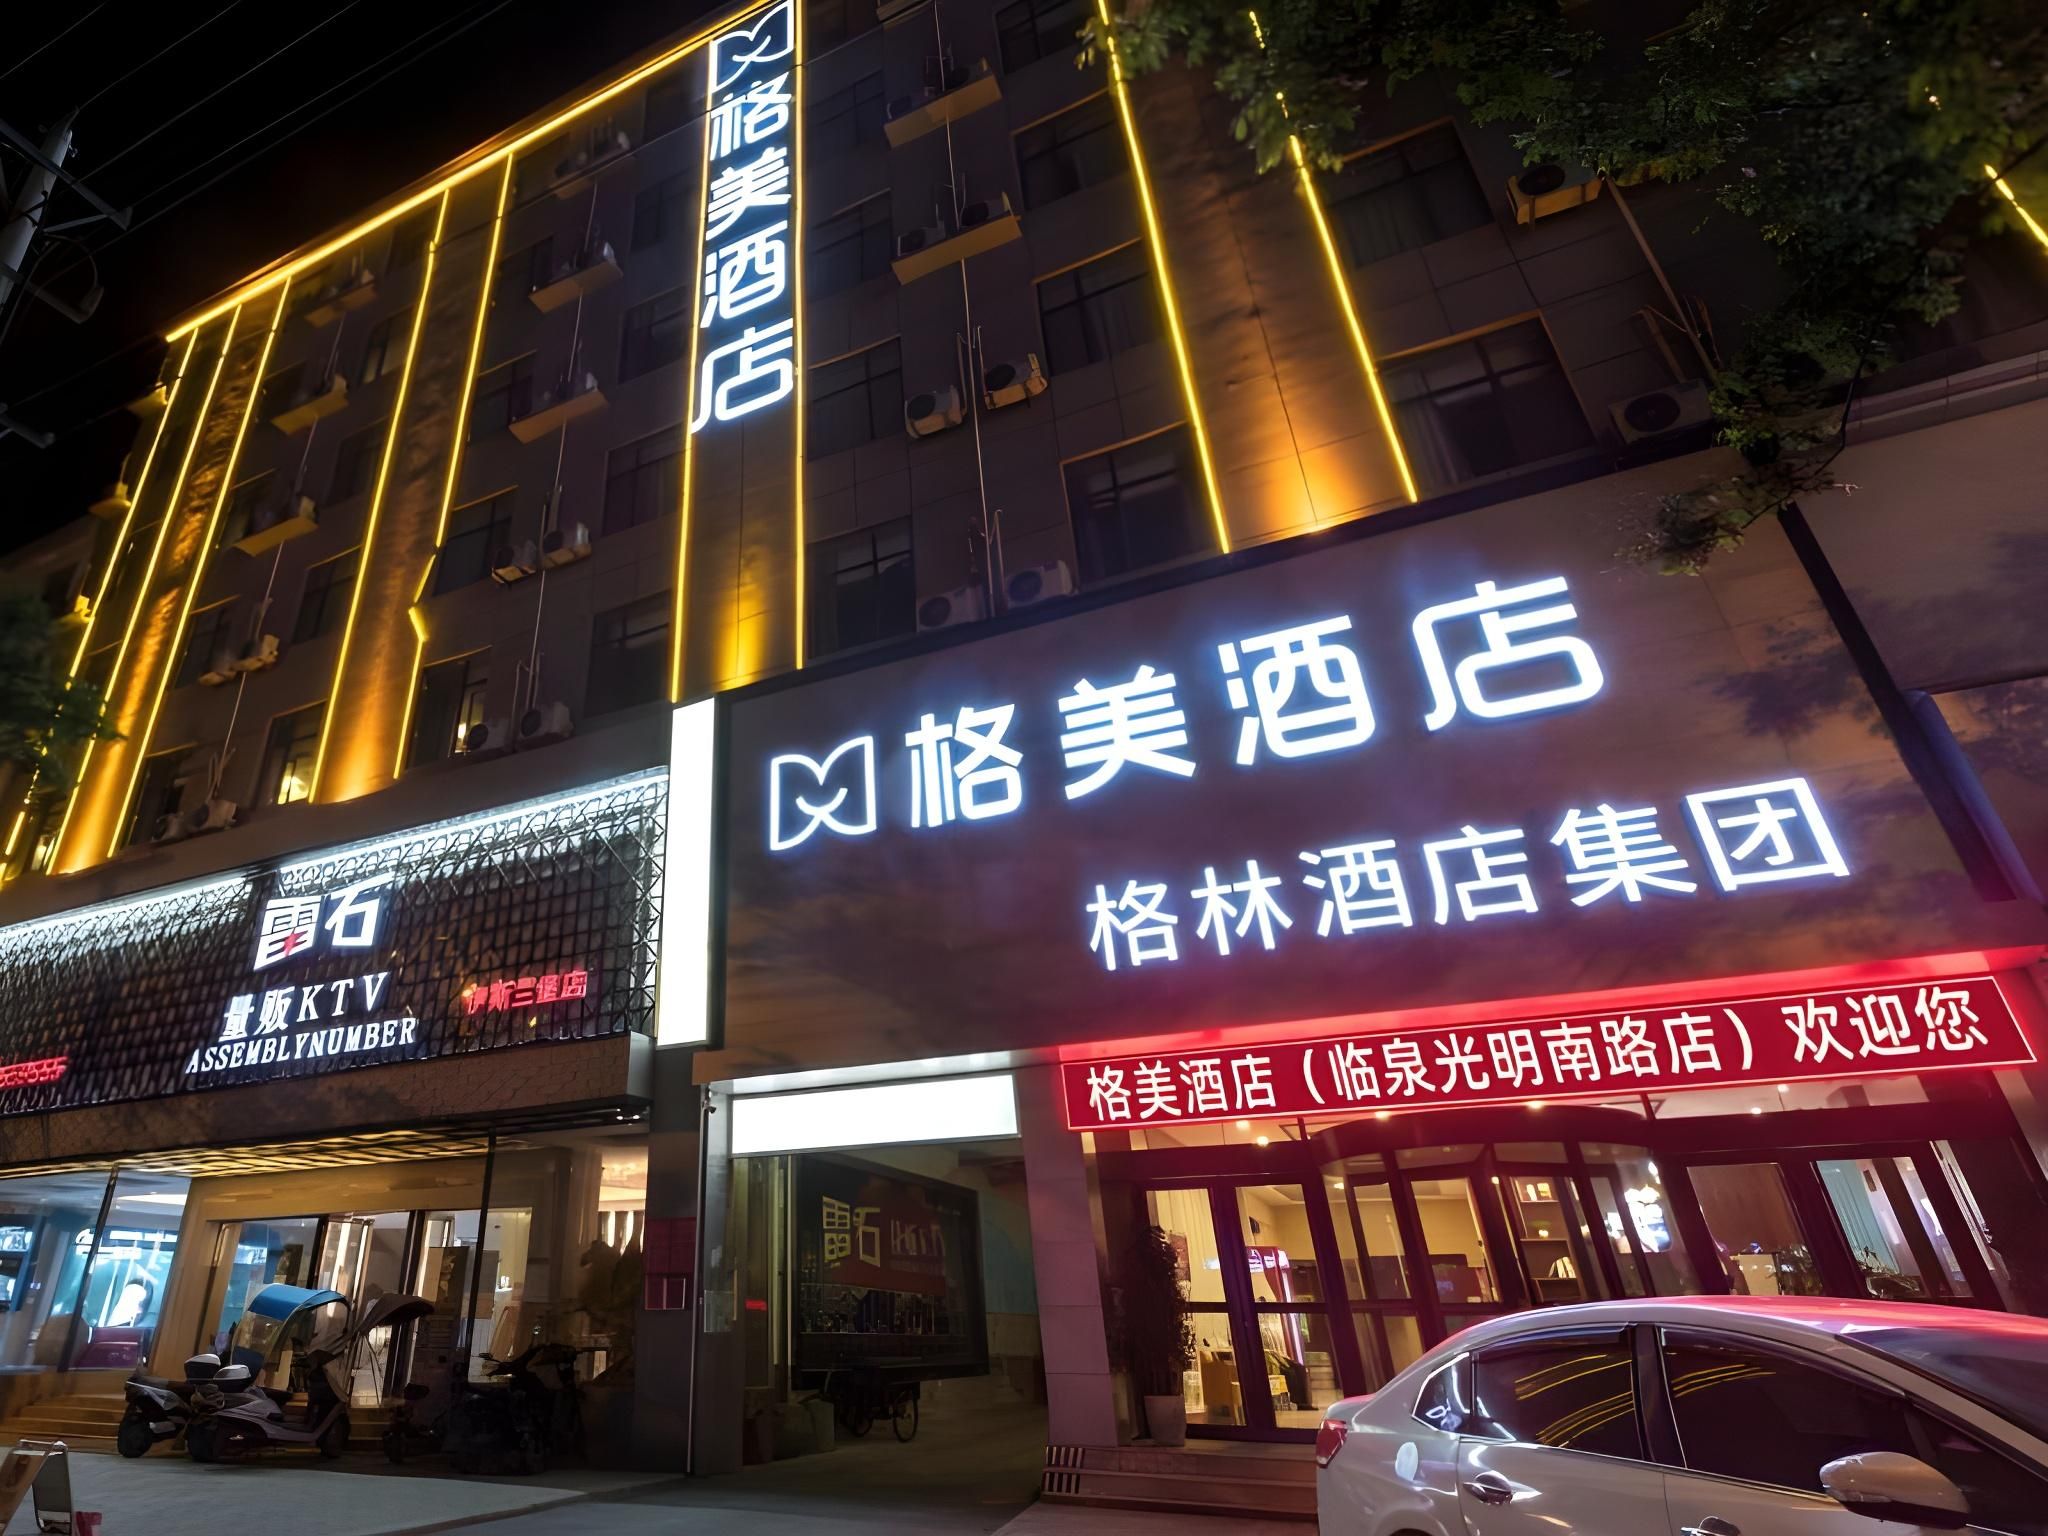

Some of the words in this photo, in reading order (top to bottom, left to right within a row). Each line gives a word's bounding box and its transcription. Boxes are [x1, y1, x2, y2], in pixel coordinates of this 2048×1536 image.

[689, 71, 794, 434] 格美酒店
[904, 575, 1605, 829] 格美酒店
[1086, 777, 1851, 973] 格林酒店集团
[185, 1017, 417, 1074] ASSEMBLYNUMBER
